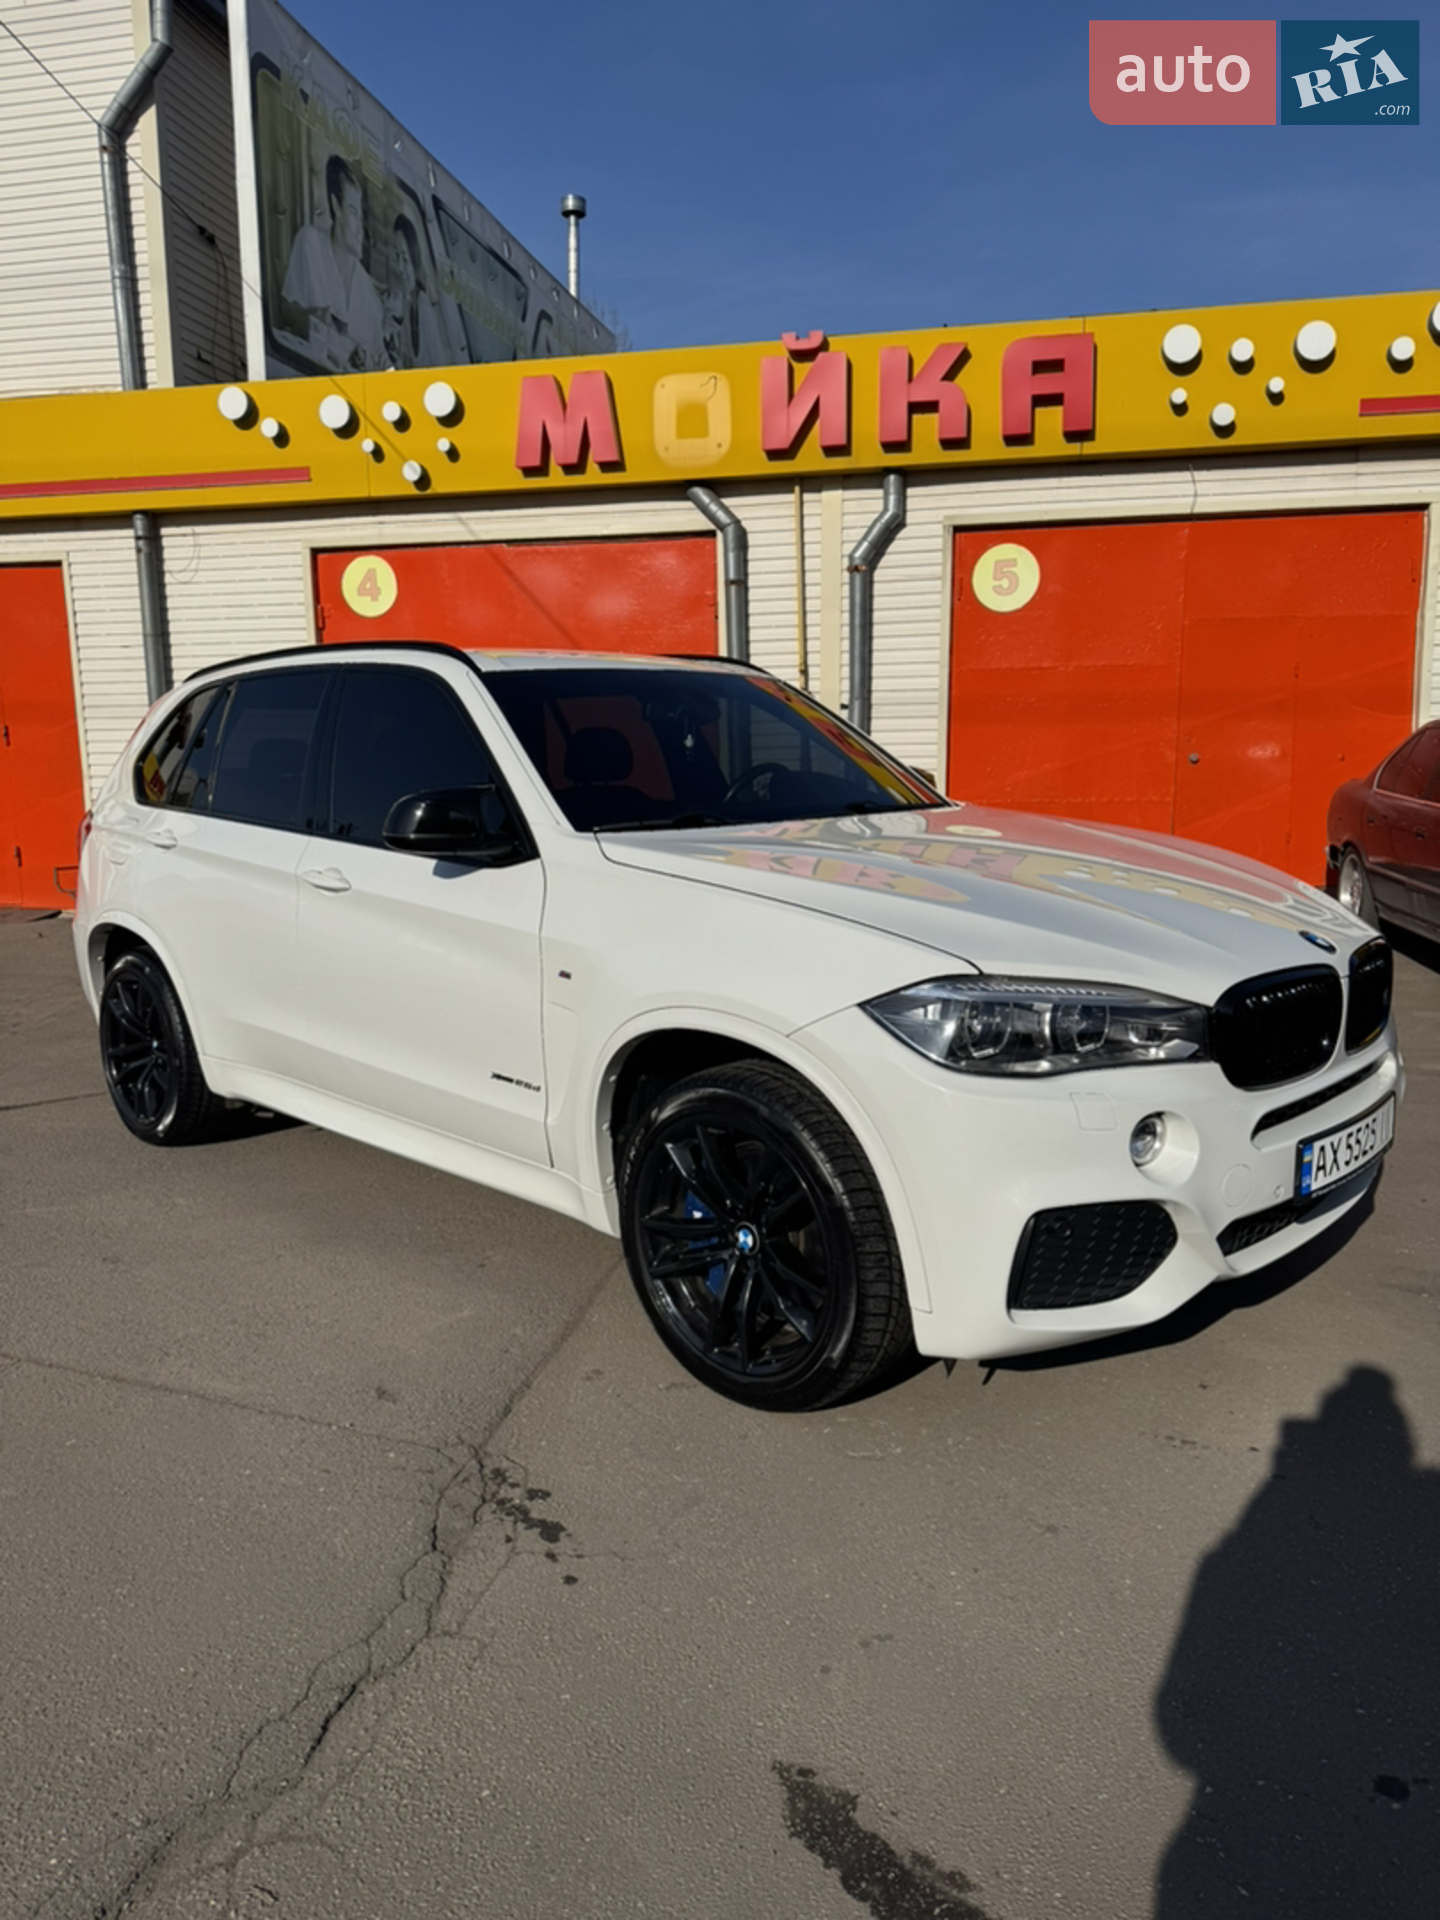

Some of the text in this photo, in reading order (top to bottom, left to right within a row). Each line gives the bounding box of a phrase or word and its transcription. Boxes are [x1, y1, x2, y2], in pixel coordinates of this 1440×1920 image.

[515, 330, 1095, 469] МОЙКА
[357, 568, 381, 602] 4
[992, 558, 1020, 597] 5
[1313, 1136, 1342, 1182] AX
[1344, 1117, 1378, 1168] 5525
